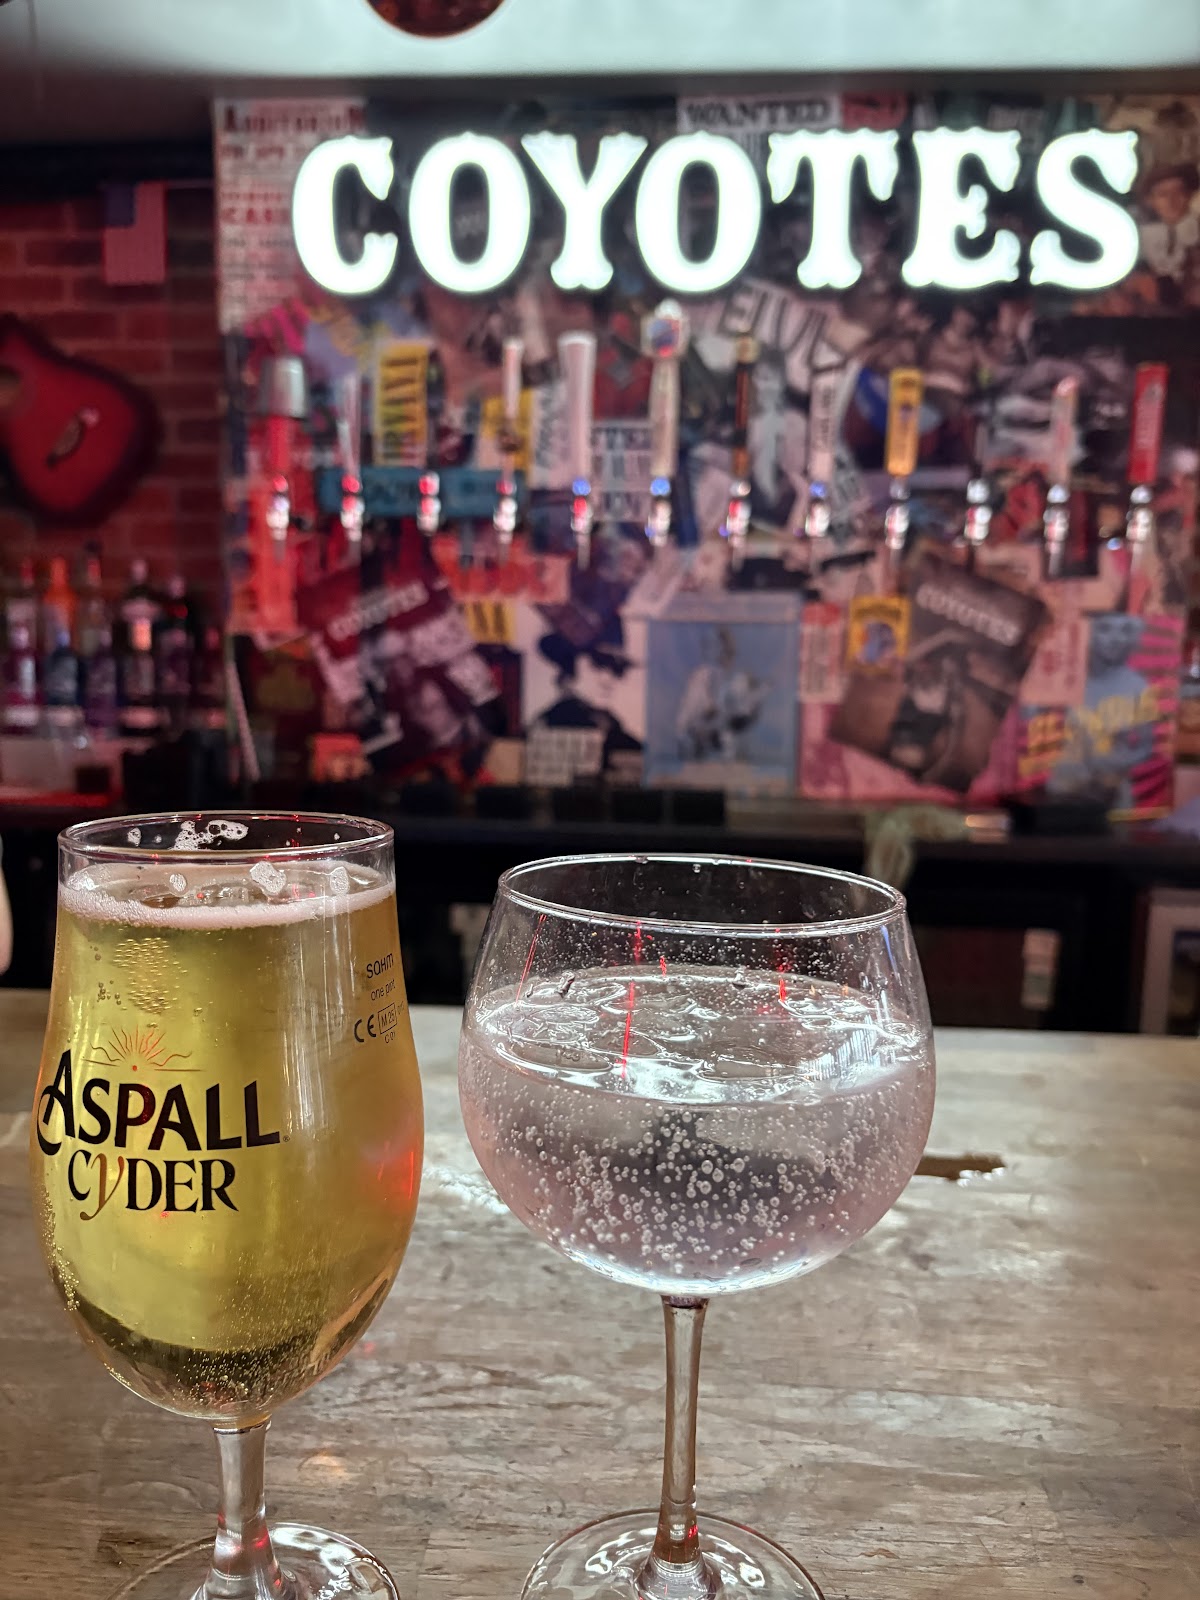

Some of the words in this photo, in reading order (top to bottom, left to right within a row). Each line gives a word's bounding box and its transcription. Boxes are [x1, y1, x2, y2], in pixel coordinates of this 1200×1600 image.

[686, 101, 832, 127] WANTED
[292, 127, 1140, 294] COYOTES
[370, 987, 385, 1001] one
[354, 1014, 377, 1043] CE
[37, 1049, 281, 1156] ASPALL
[68, 1149, 239, 1221] CYDER
